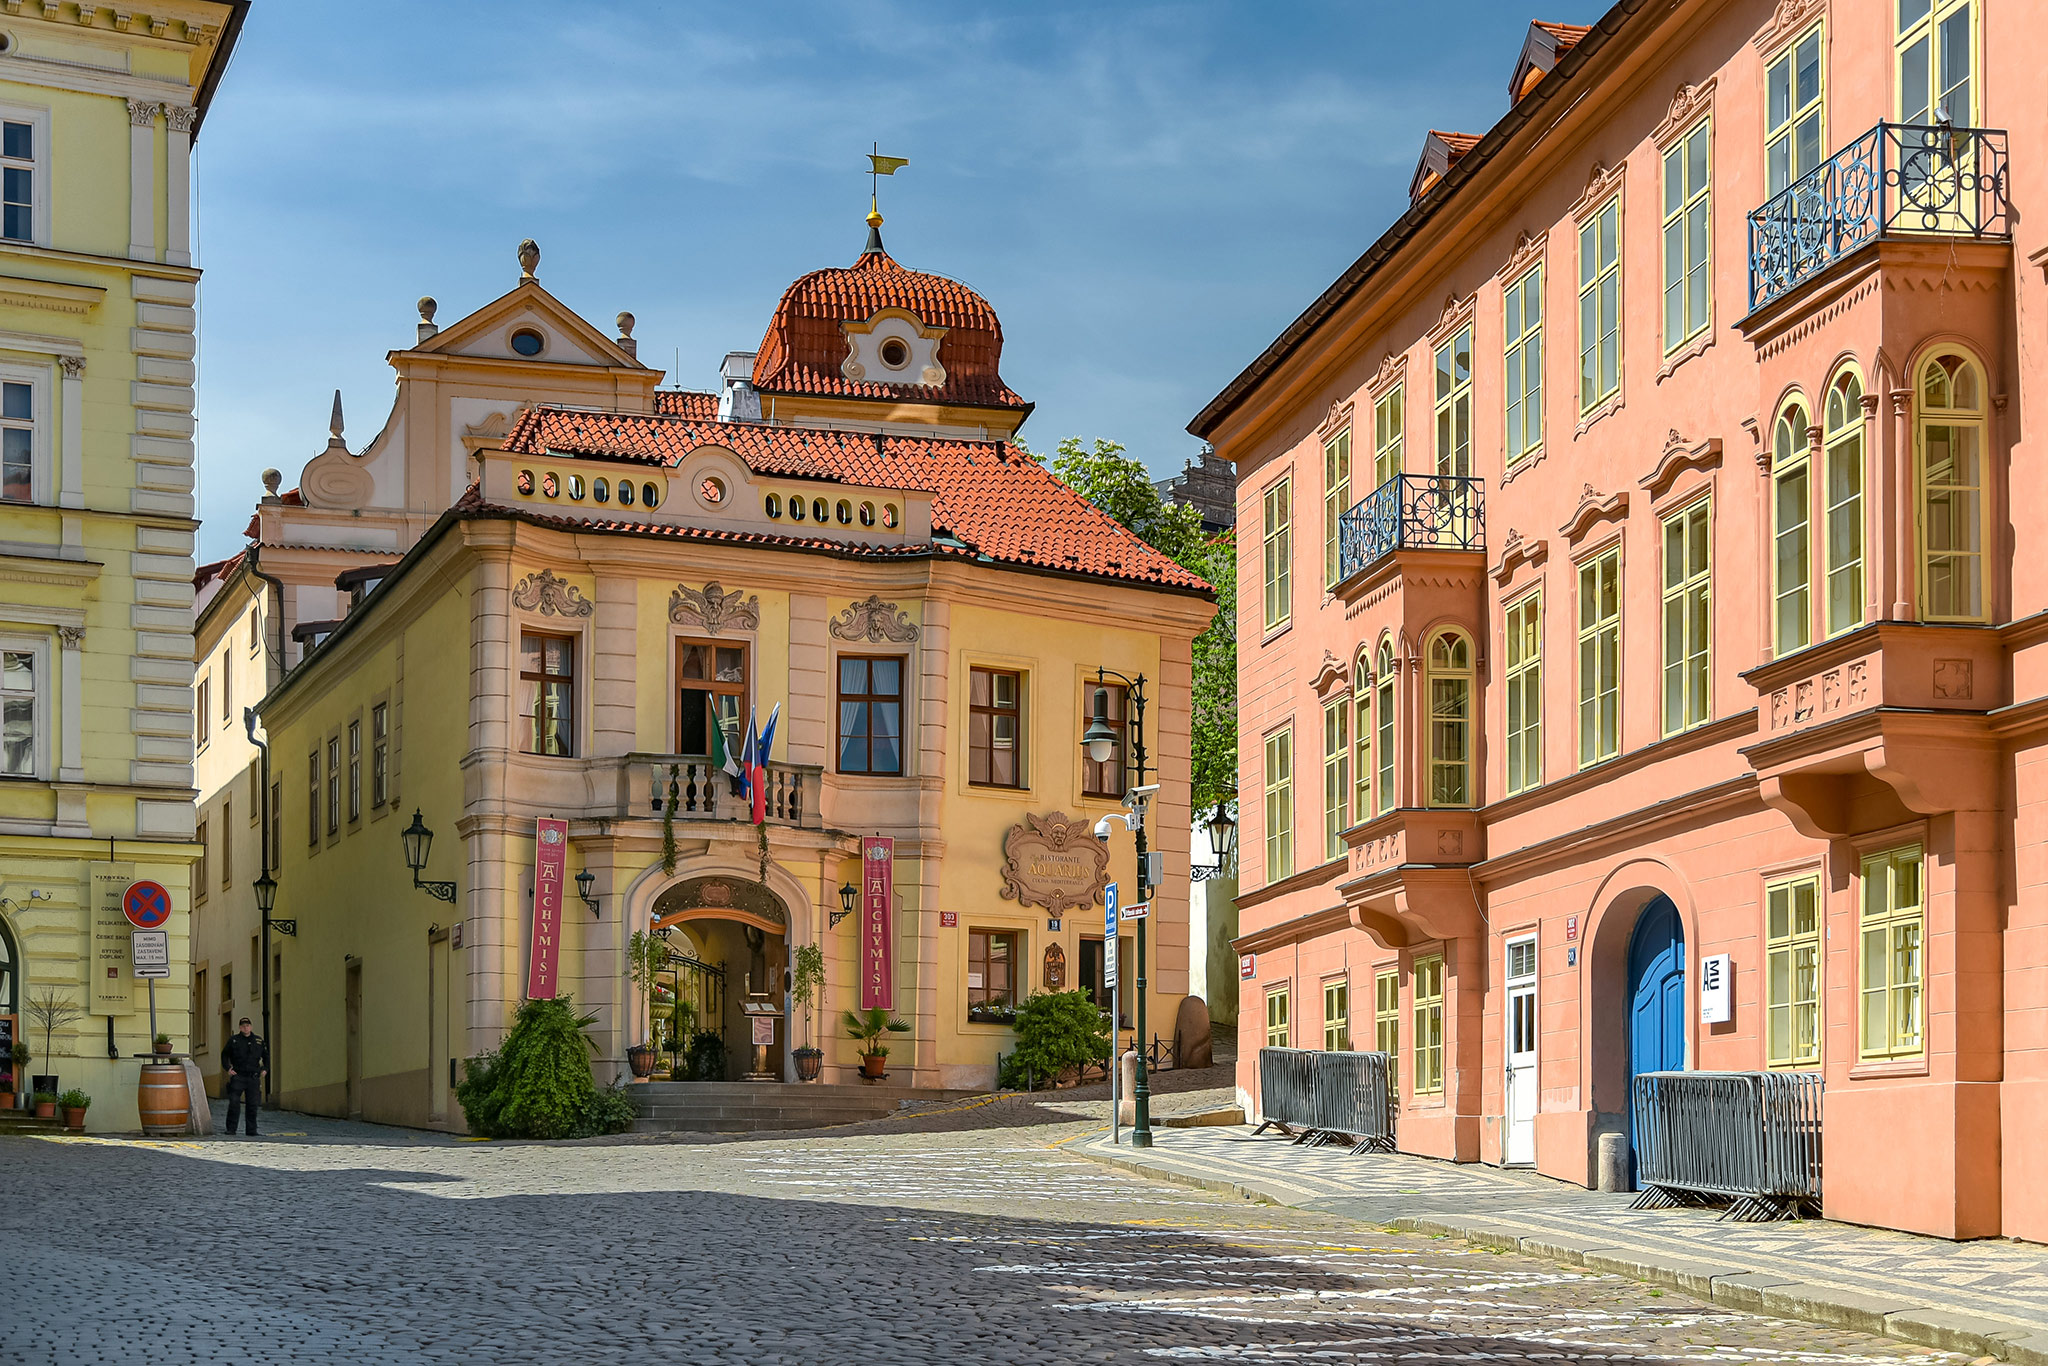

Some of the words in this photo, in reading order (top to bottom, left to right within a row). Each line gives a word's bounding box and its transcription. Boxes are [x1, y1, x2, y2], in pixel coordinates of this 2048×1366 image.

[1040, 854, 1081, 864] RISTORANTE
[1027, 863, 1090, 878] AQUARIUS
[1107, 890, 1114, 920] P
